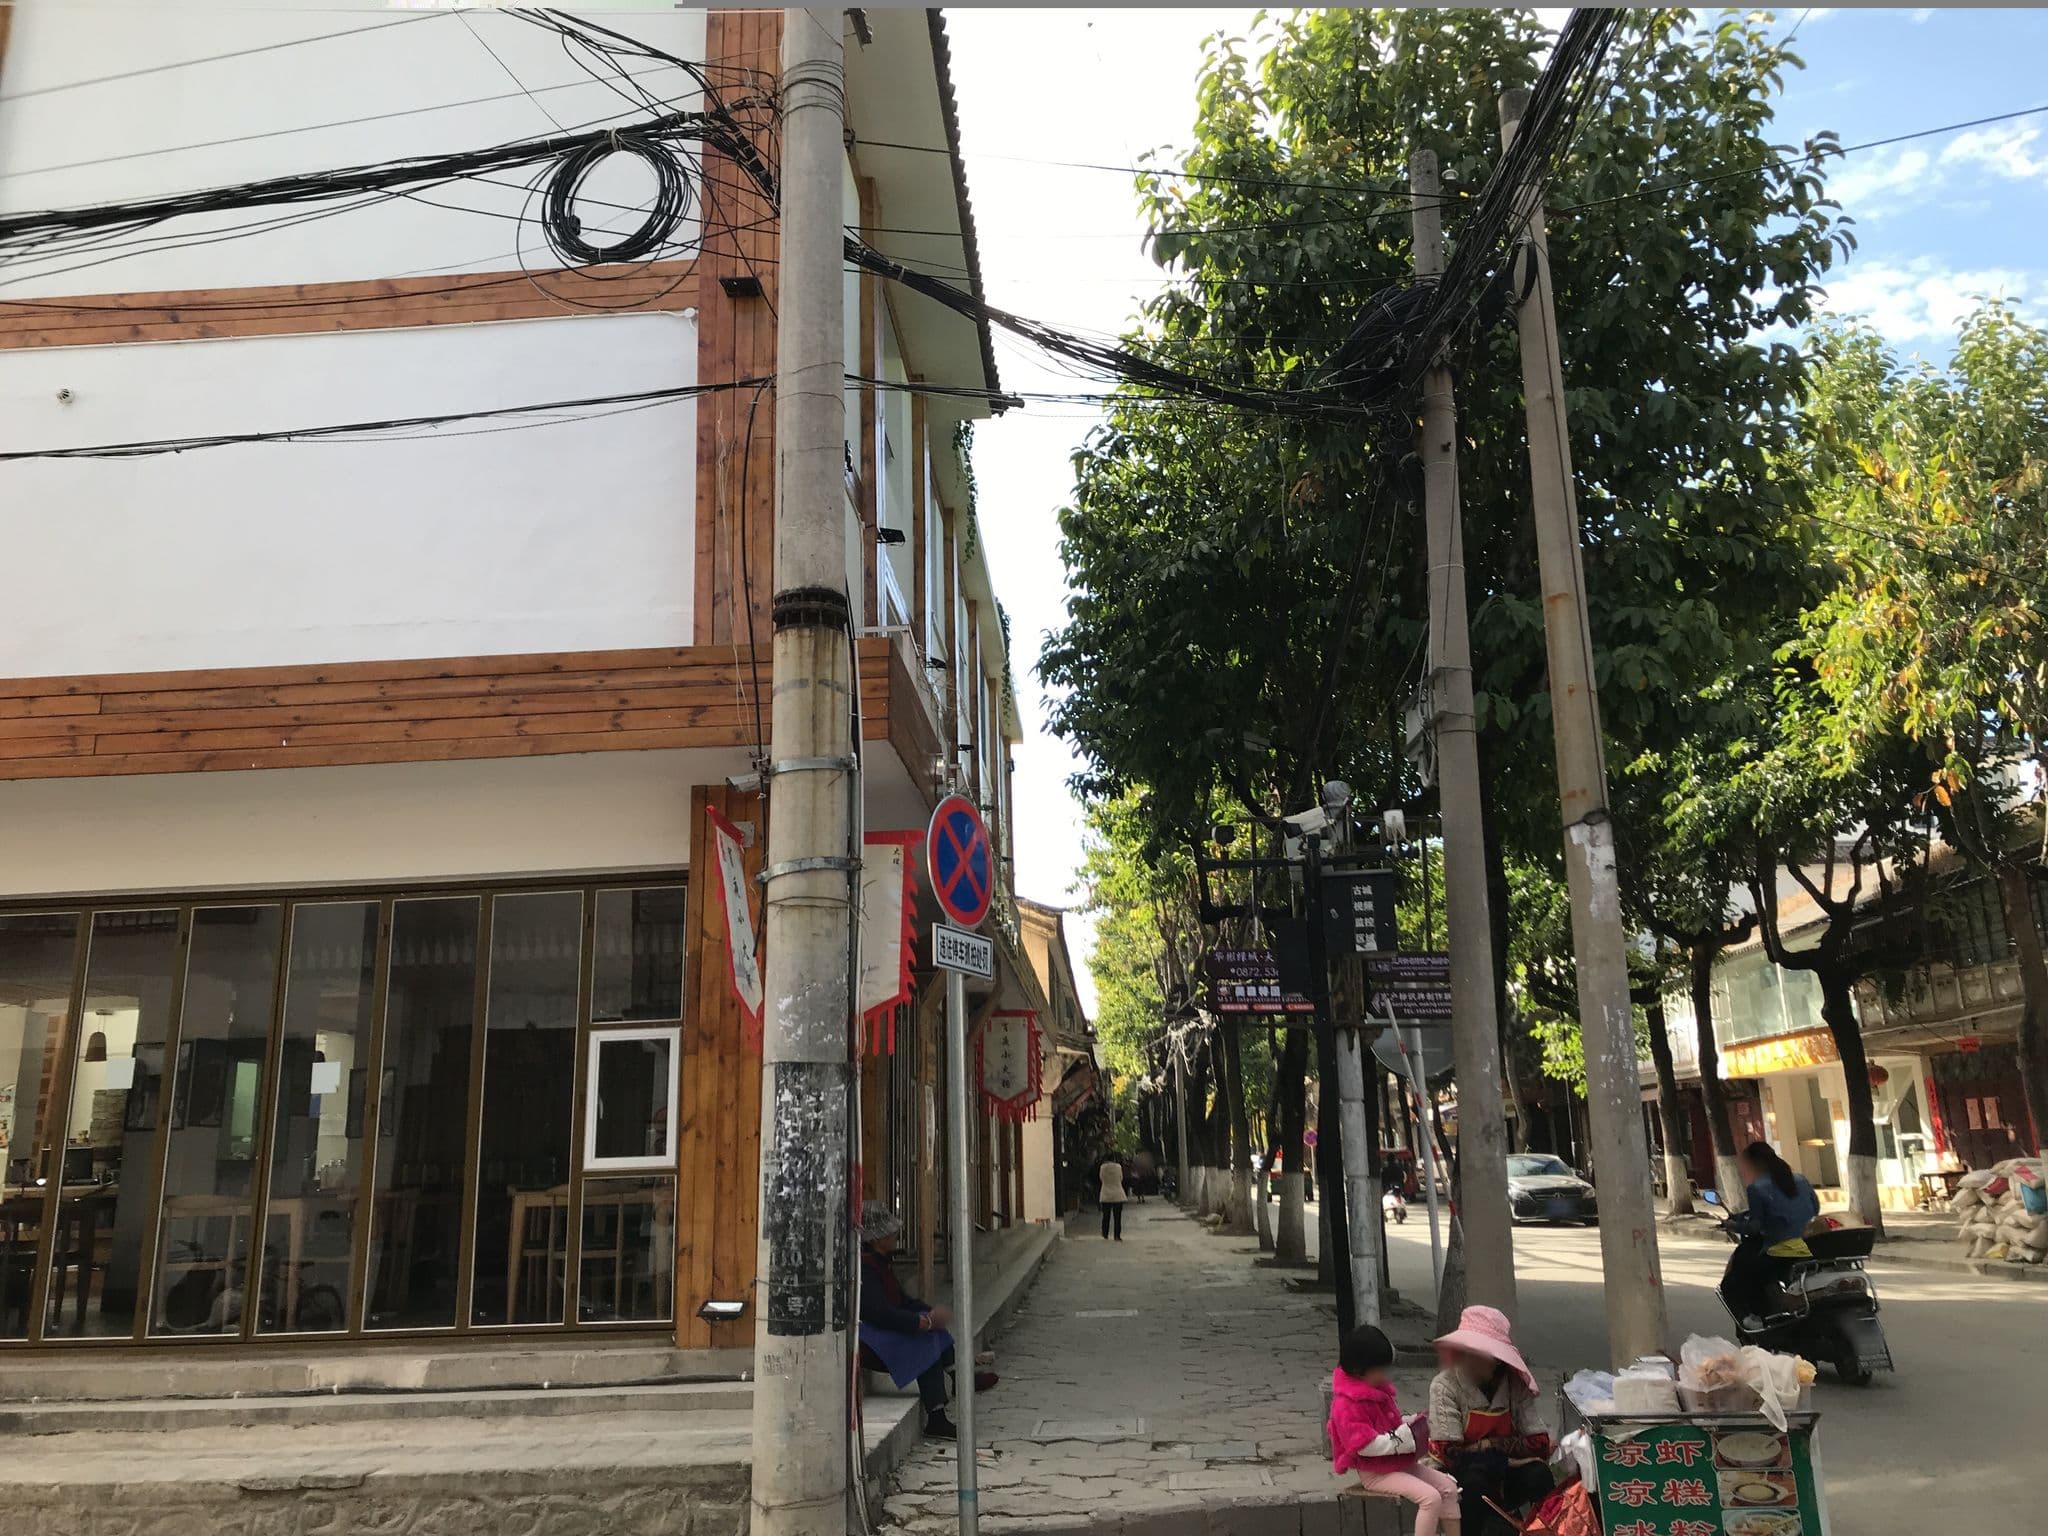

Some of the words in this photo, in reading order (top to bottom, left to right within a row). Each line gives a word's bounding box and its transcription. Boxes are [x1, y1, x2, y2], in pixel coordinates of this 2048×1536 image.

[1352, 884, 1373, 896] 古城
[1354, 901, 1374, 911] 视频
[1355, 917, 1375, 927] 监控
[940, 934, 988, 972] 违法停车抓拍处罚
[1603, 1440, 1705, 1467] 凉虾
[1609, 1478, 1713, 1507] 凉糕
